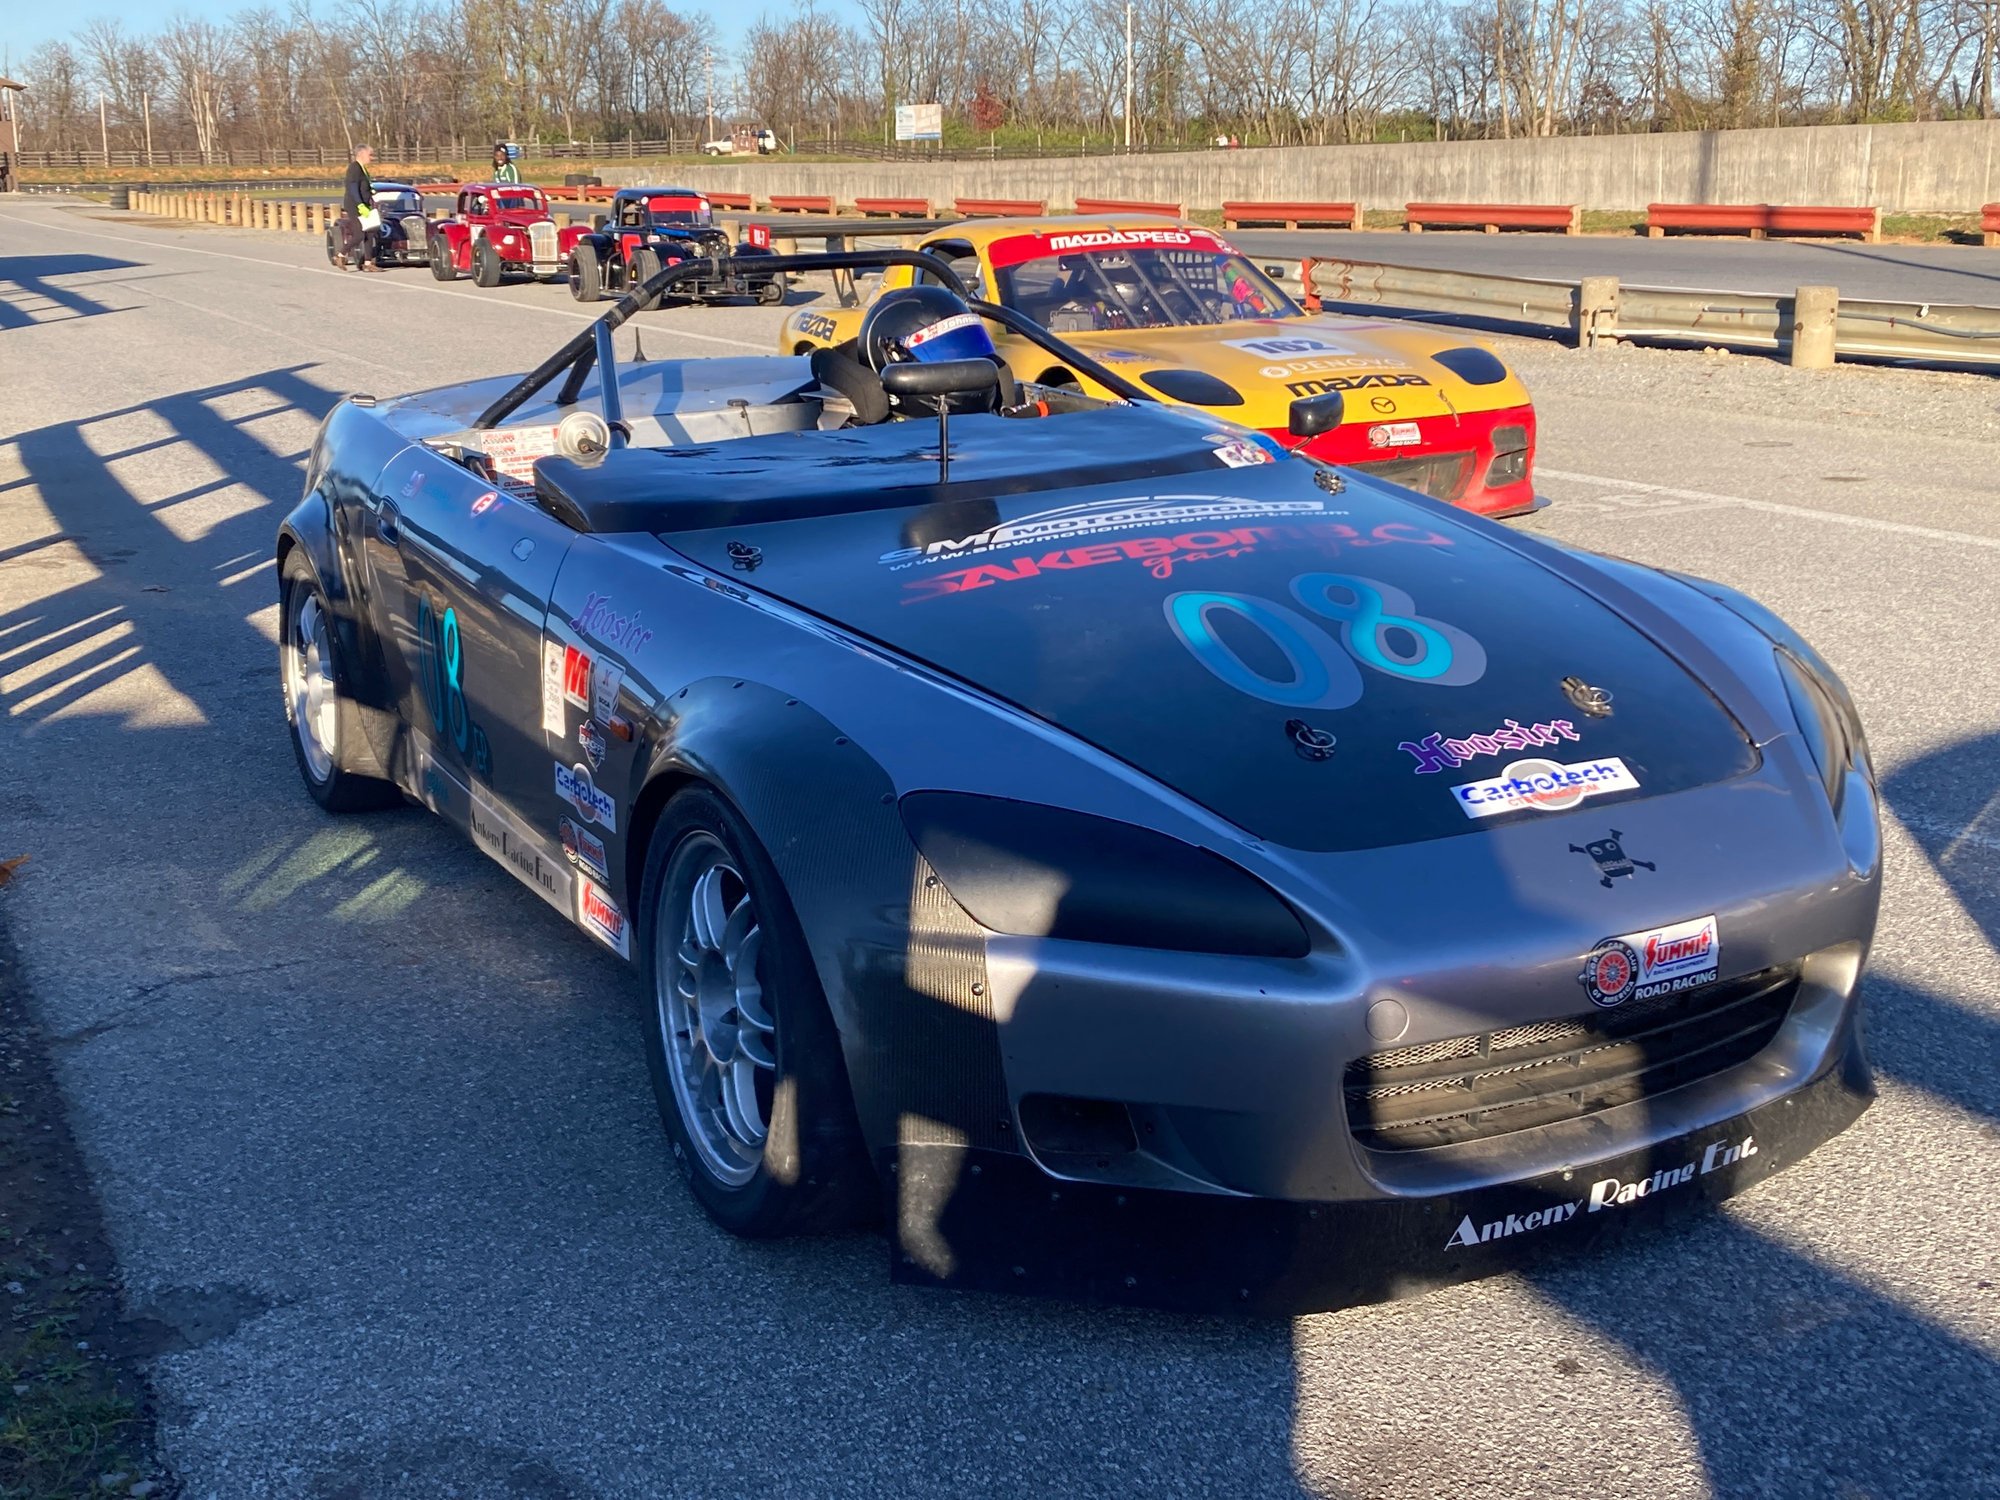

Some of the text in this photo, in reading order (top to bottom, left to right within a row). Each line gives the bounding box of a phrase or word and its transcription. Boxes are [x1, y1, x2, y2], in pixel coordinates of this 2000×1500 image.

[1050, 231, 1191, 250] MAZDASPEED
[1242, 339, 1339, 354] 162
[1288, 357, 1406, 372] DENOVO
[889, 510, 1350, 572] www.slowmotionmotorsports.com
[1012, 501, 1314, 537] MOTORSPORTS
[570, 591, 654, 655] Hoosier
[1163, 572, 1487, 710] 08
[417, 590, 472, 768] 08
[1397, 718, 1580, 775] Hoosier
[556, 766, 612, 818] Carbotech
[1460, 764, 1620, 805] Carbotech
[1635, 969, 1717, 1001] ROAD RACING
[1443, 1135, 1759, 1252] Ankeny Racing Ent.
